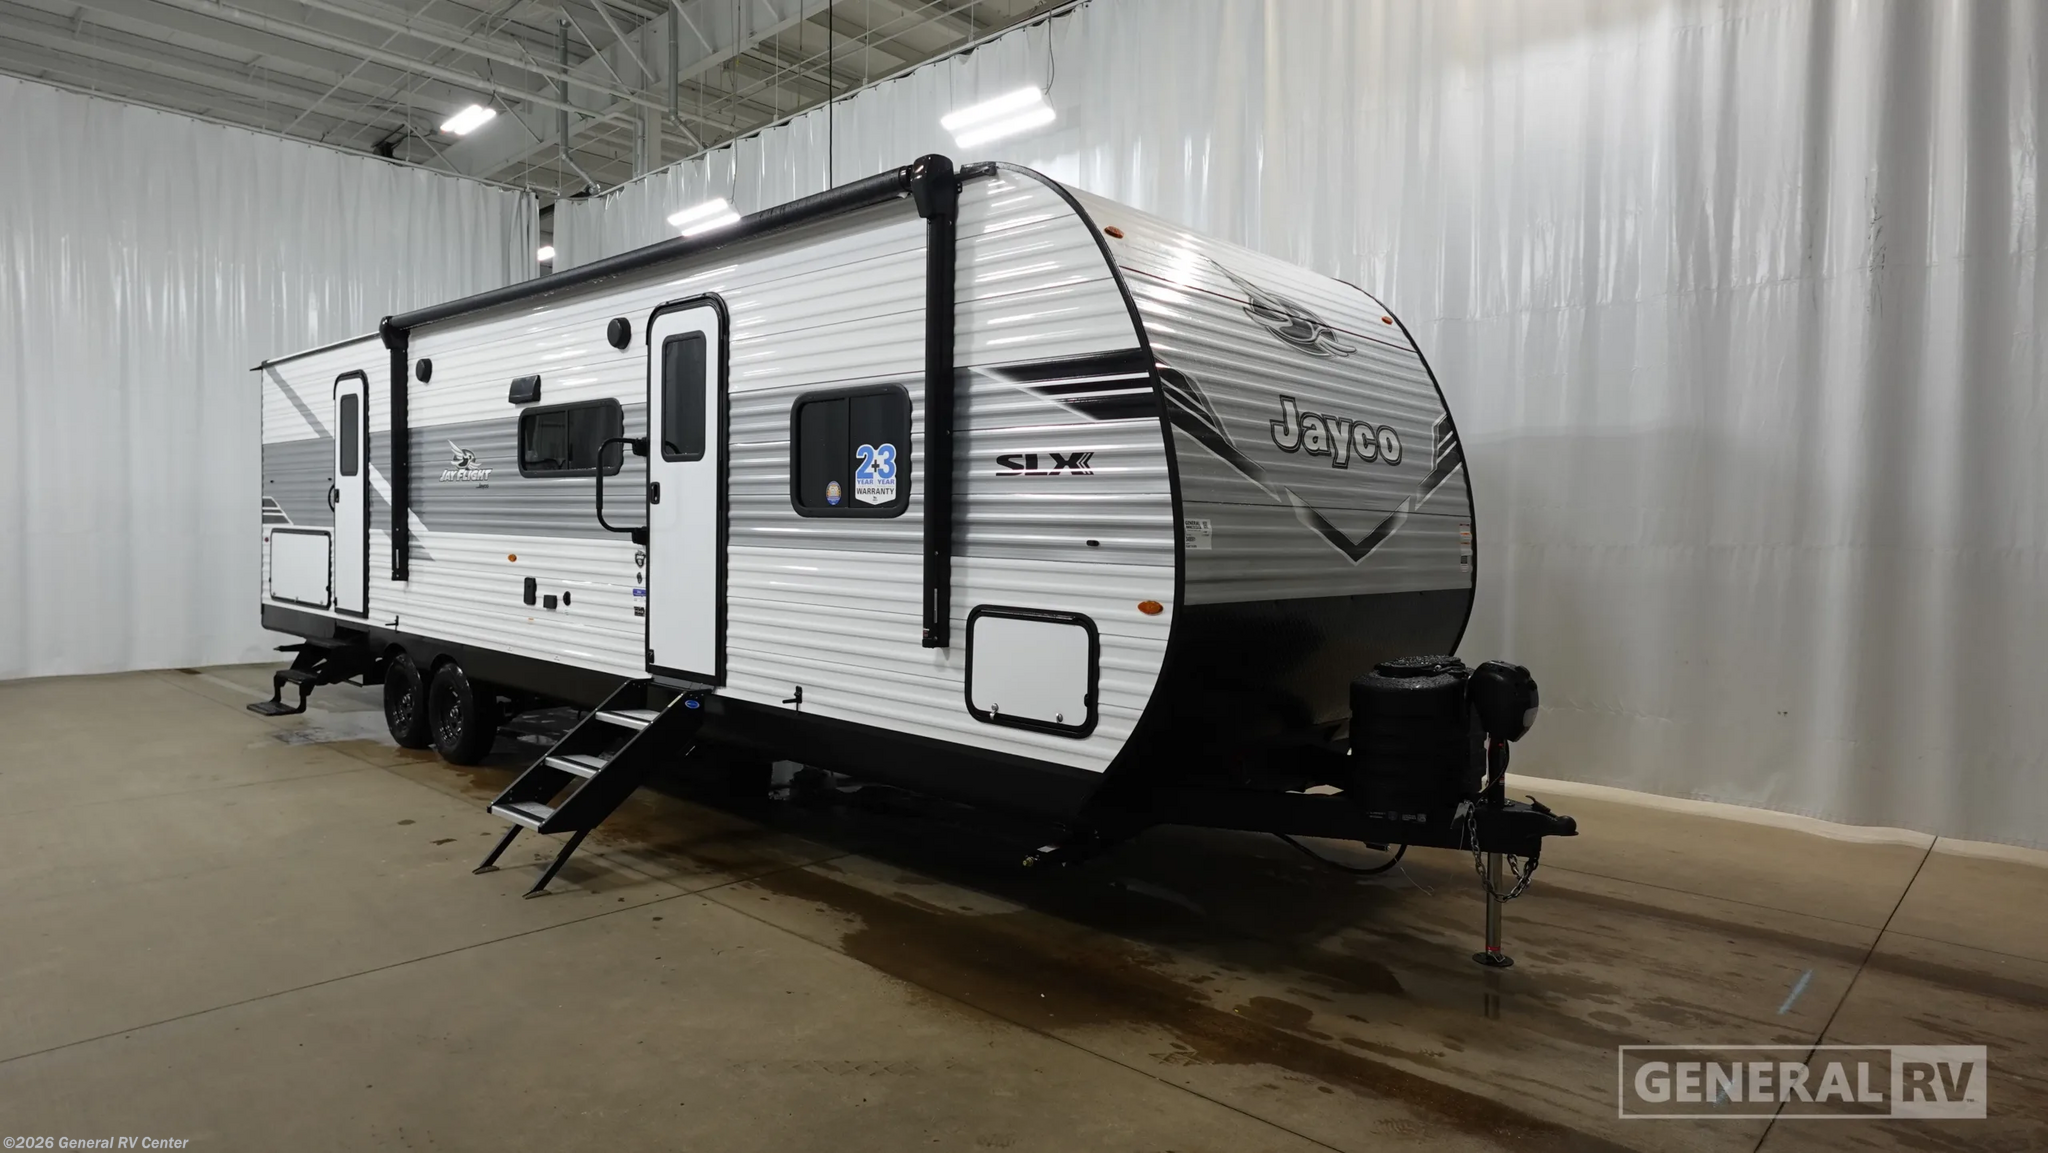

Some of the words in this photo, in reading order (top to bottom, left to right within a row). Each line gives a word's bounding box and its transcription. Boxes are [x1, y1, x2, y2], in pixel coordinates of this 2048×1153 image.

[1269, 394, 1402, 469] Jayco
[996, 452, 1094, 476] SLX
[439, 469, 457, 482] JAY
[456, 468, 492, 482] FLIGHT
[857, 487, 895, 495] WARRANTY
